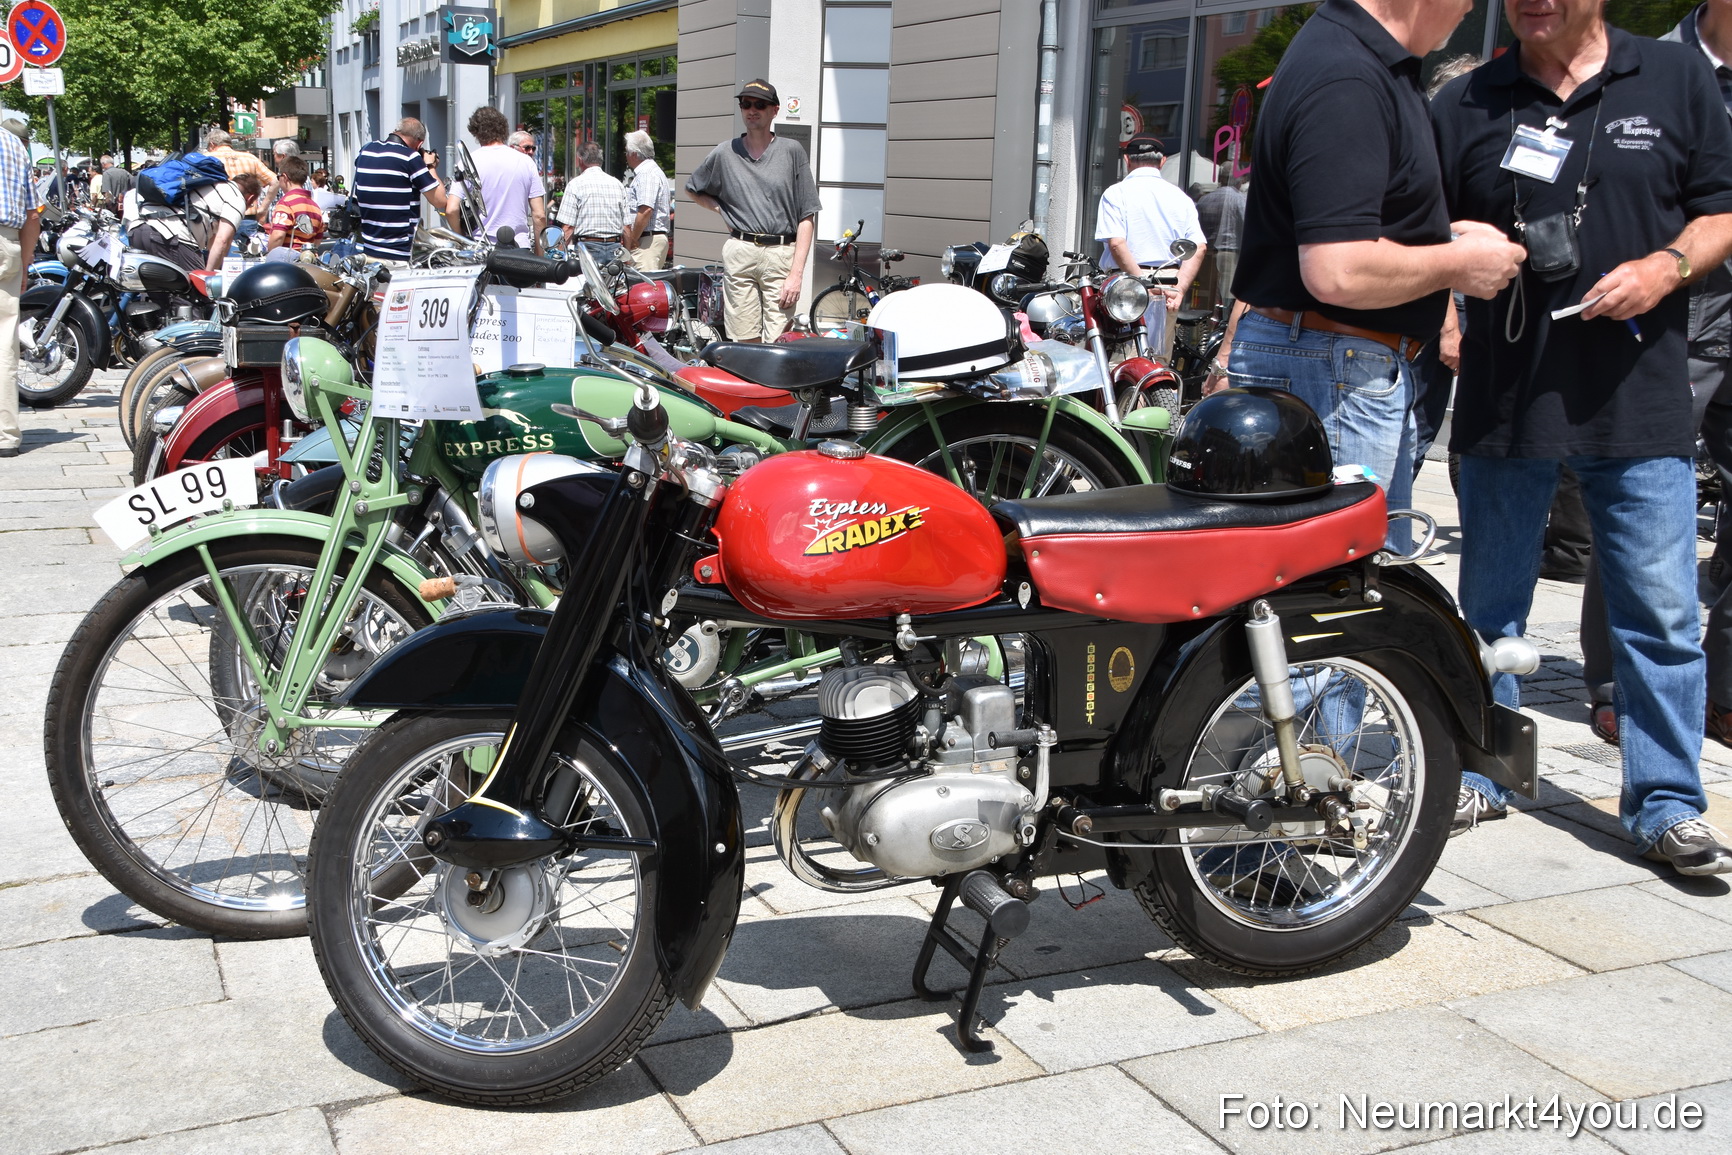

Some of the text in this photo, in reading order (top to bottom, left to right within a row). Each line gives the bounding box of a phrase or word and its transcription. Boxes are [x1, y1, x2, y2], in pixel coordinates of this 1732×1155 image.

[461, 21, 480, 46] G2
[419, 297, 450, 329] 309
[474, 316, 508, 327] xpress
[470, 330, 523, 343] adex 200
[469, 345, 485, 356] 53
[1026, 356, 1041, 383] ELLUNG
[444, 433, 555, 457] EXPRESS
[128, 466, 227, 525] SL 99
[808, 498, 887, 520] Express
[824, 511, 910, 553] RADEX
[1086, 645, 1096, 710] EXPRESS
